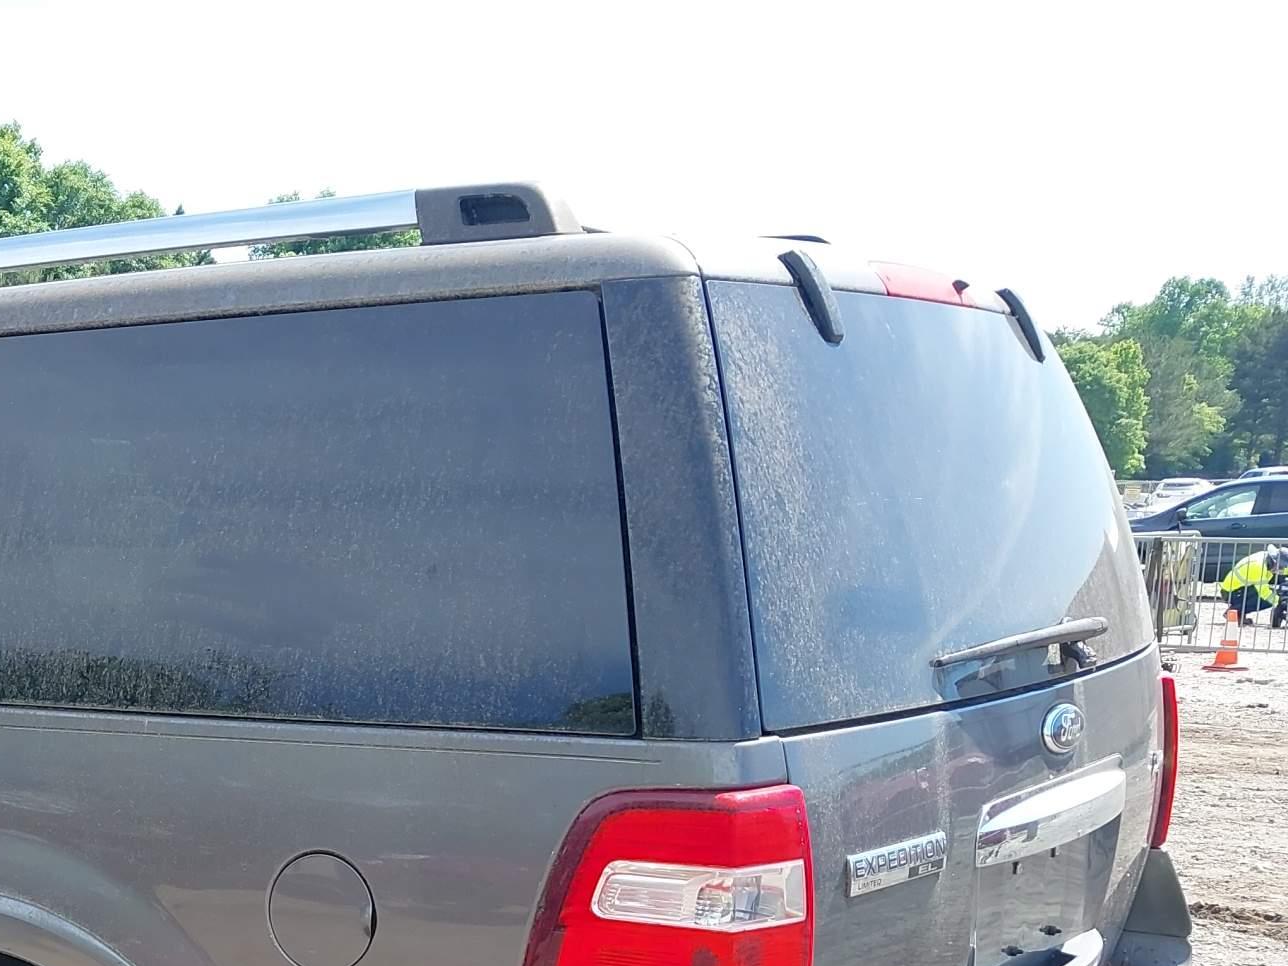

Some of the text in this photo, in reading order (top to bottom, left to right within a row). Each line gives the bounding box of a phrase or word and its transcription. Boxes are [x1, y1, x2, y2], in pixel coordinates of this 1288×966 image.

[1060, 711, 1081, 742] Ford
[854, 837, 946, 879] EXPEDITION
[917, 860, 939, 875] EL
[857, 879, 882, 891] LIMITED
